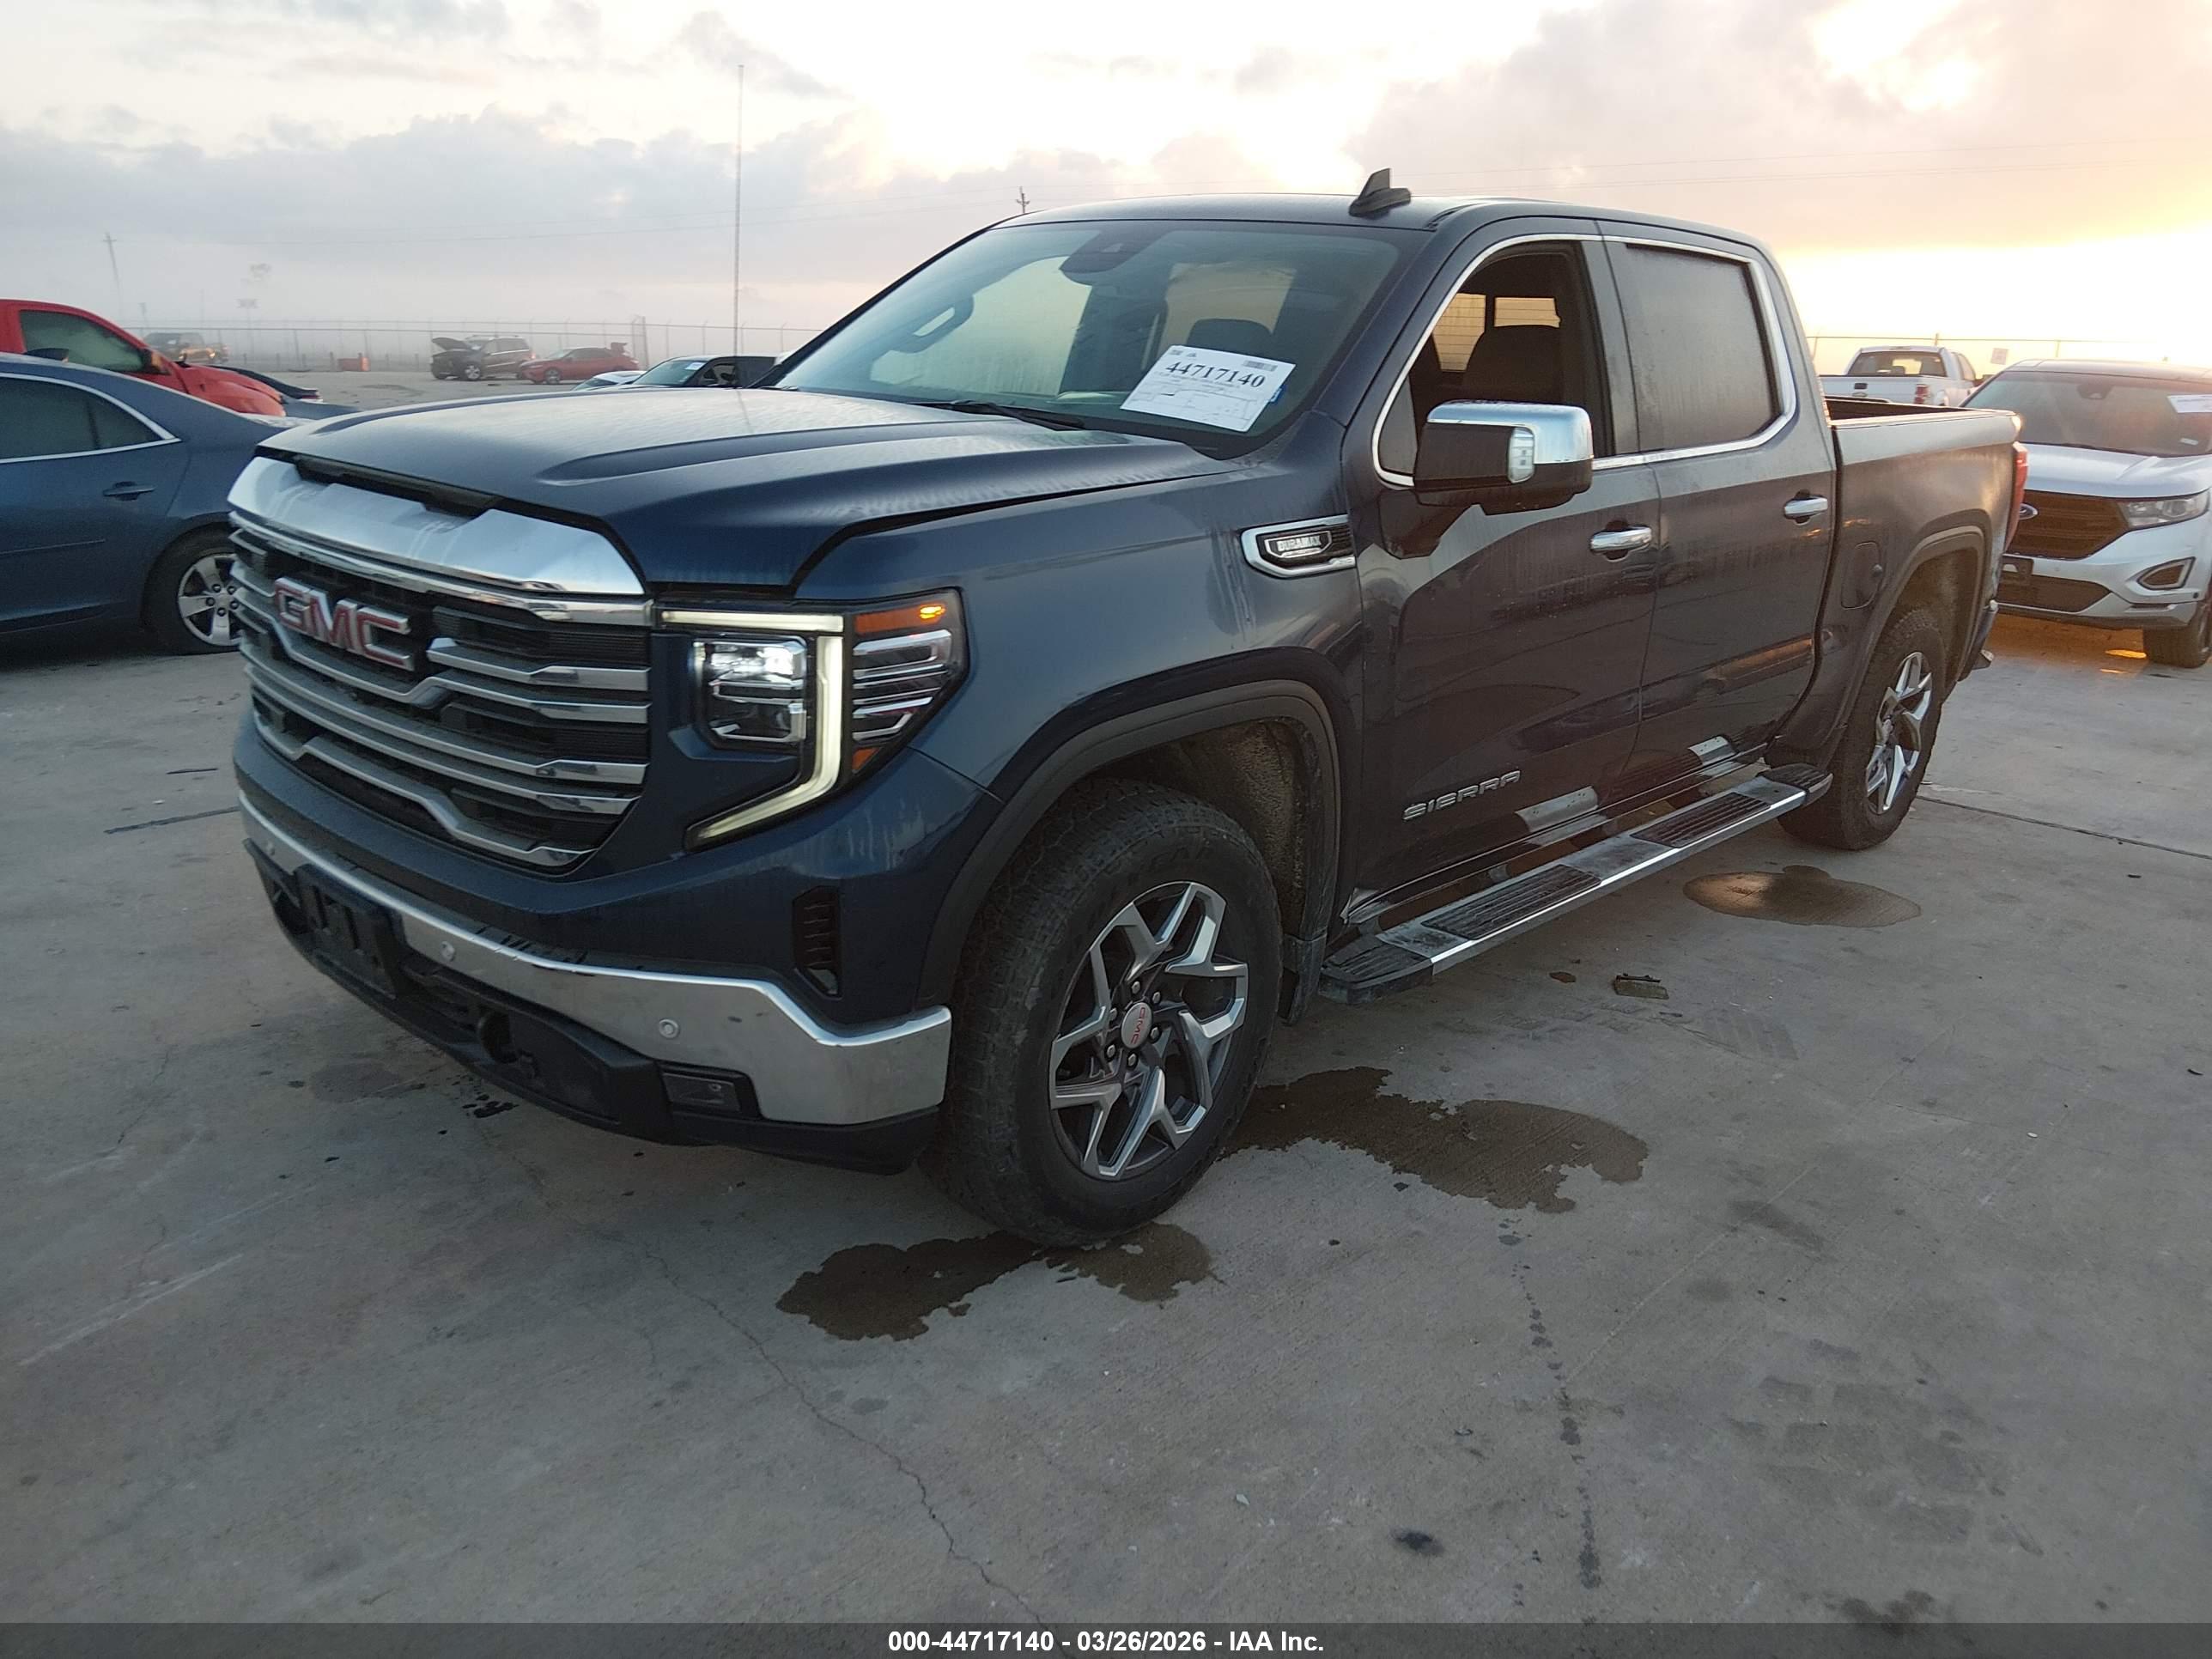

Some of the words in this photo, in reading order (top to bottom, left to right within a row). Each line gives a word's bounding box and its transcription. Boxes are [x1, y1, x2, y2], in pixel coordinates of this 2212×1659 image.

[1165, 361, 1266, 388] 44717140
[274, 577, 415, 671] GMC
[1402, 770, 1521, 821] SIERRA
[1130, 1006, 1146, 1045] GMC
